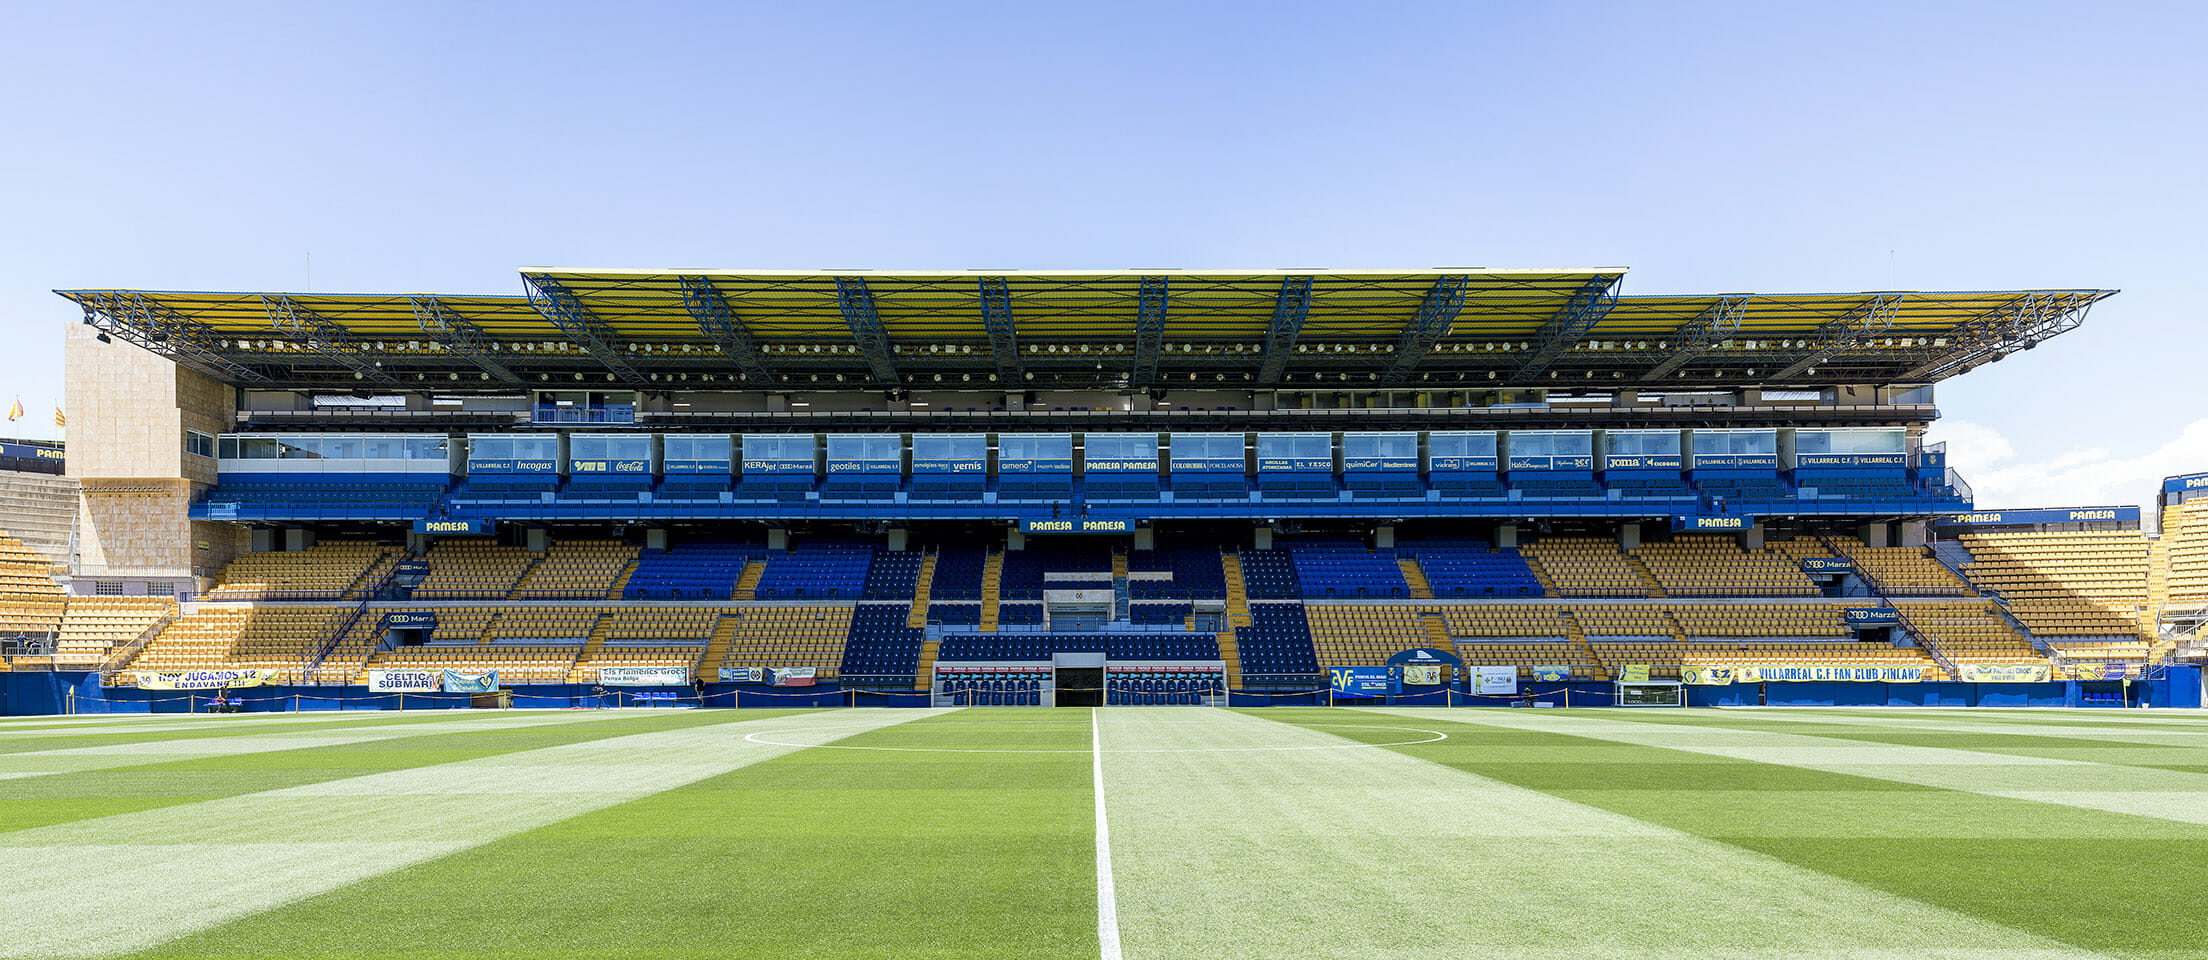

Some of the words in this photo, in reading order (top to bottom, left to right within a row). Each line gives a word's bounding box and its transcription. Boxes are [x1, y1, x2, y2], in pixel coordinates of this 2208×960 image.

[517, 461, 552, 471] Incogas
[830, 462, 861, 472] geotiles
[1086, 462, 1120, 470] PAMESA
[1123, 462, 1157, 470] PAMESA
[1958, 514, 2001, 523] PAMESA
[2070, 510, 2115, 520] PAMESA
[426, 522, 468, 532] PAMESA
[1030, 522, 1072, 530] PAMESA
[1083, 522, 1126, 530] PAMESA
[1698, 518, 1742, 528] PAMESA
[185, 671, 239, 682] JUGAMOS
[243, 670, 256, 679] 12
[1759, 668, 1813, 680] VILLARREAL
[1834, 668, 1851, 680] FAN
[1855, 668, 1878, 680] CLUB
[1882, 668, 1921, 680] FINLAND
